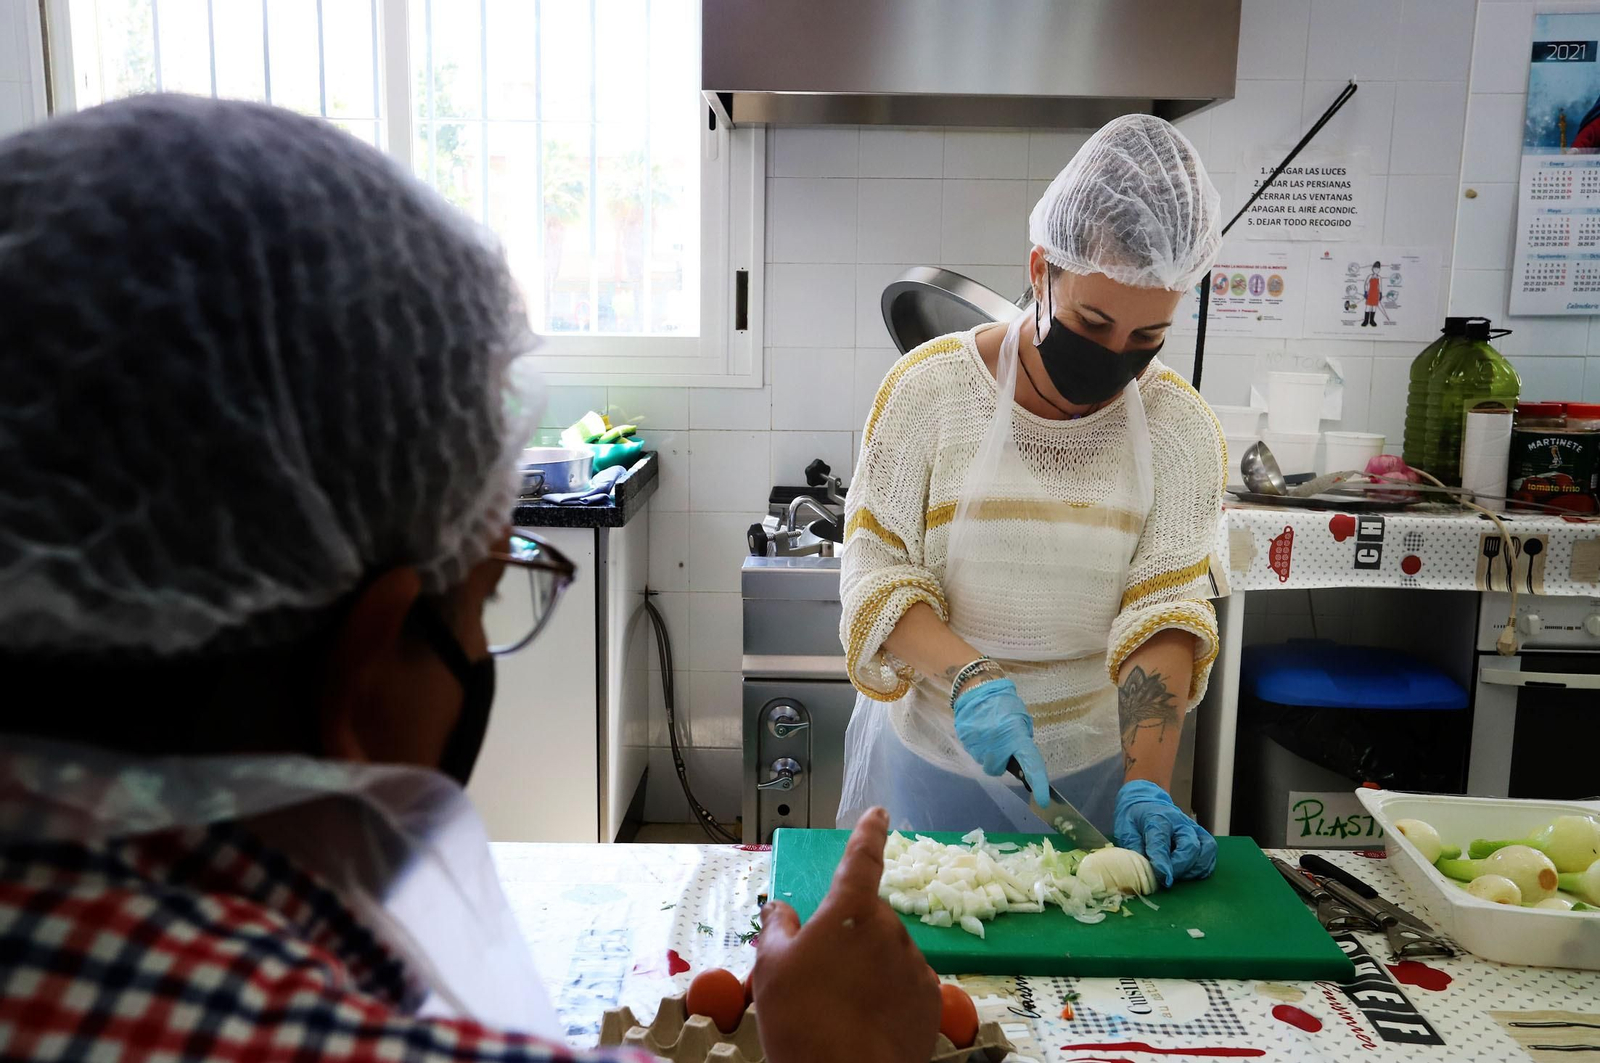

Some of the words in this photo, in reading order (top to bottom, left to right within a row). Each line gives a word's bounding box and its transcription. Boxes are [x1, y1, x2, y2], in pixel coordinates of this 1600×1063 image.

[1546, 44, 1586, 60] 2021
[1269, 167, 1303, 175] AAGAR
[1321, 168, 1346, 176] LUCES
[1306, 181, 1351, 189] PERSIANAS
[1259, 192, 1290, 200] CERRAR
[1251, 205, 1285, 213] APAGAR
[1318, 206, 1358, 214] ACONDIC.
[1256, 218, 1281, 226] DEJAR
[1283, 218, 1307, 226] TODO
[1309, 219, 1352, 227] RECOGIDO
[1527, 437, 1583, 454] MARTINETE
[1528, 483, 1560, 493] tomate
[1562, 484, 1580, 493] frito
[1292, 799, 1384, 840] PLAST
